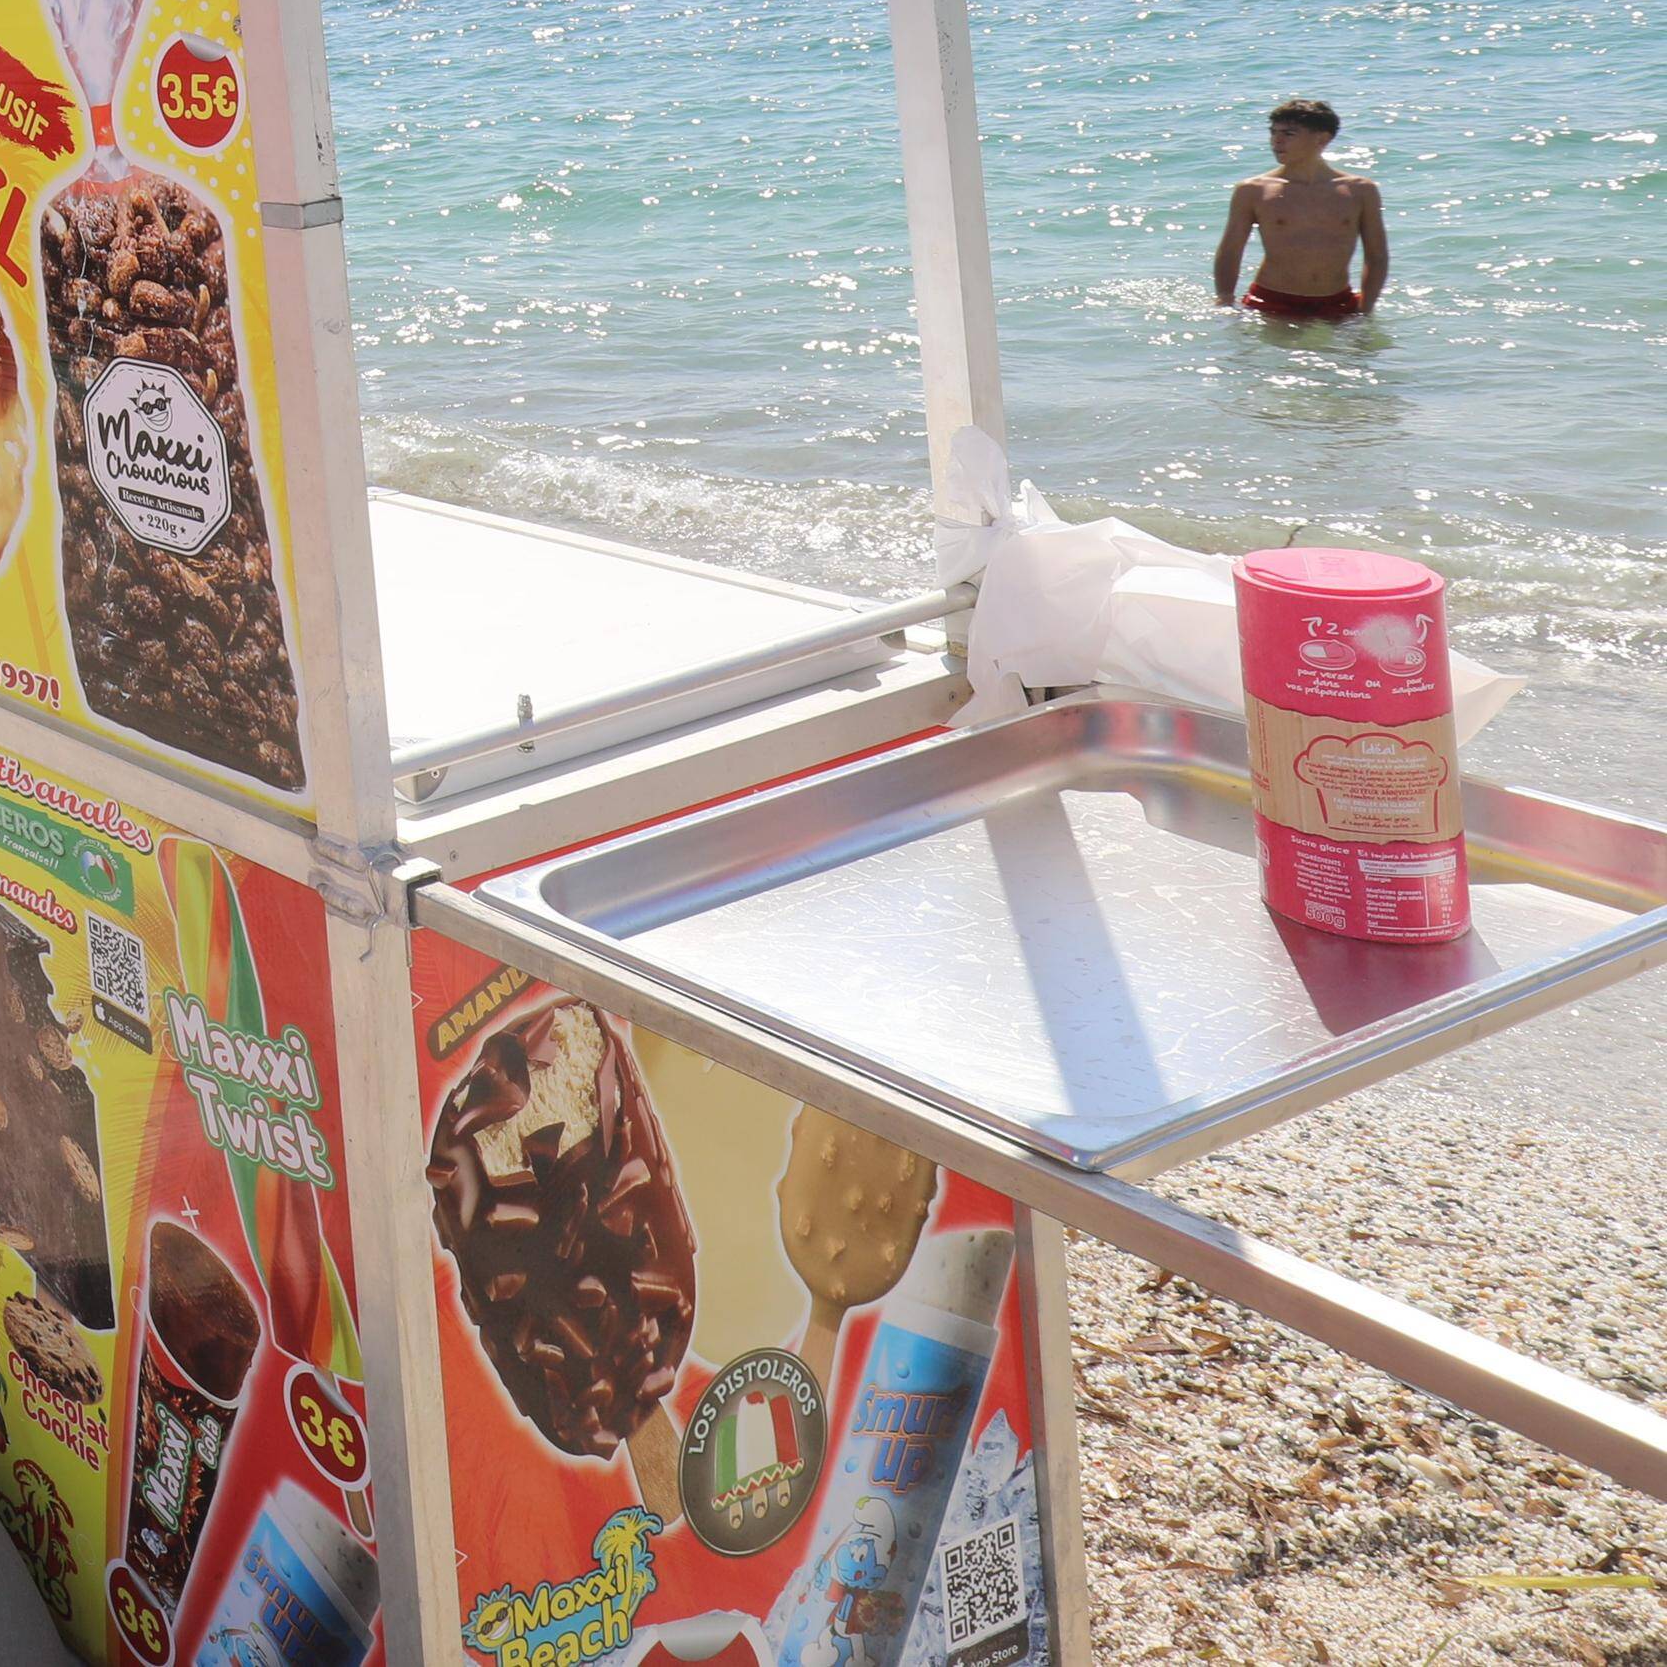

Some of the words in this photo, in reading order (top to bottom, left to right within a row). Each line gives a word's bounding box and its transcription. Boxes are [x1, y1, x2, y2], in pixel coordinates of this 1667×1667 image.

[161, 72, 237, 120] 3.5€
[97, 409, 213, 473] Maxxi
[106, 450, 211, 496] Chouchous
[122, 489, 155, 508] Recette
[156, 496, 202, 518] Artisanale
[147, 513, 178, 538] 220g
[1312, 678, 1341, 689] dans
[1361, 740, 1396, 756] Idéal
[1290, 835, 1317, 848] Sucre
[1319, 843, 1350, 855] glace
[108, 1015, 124, 1032] App
[124, 1024, 147, 1044] Store
[169, 997, 312, 1099] Maxxi
[189, 1073, 327, 1179] Twist
[8, 1350, 111, 1455] Chocolat
[21, 1389, 100, 1471] Cookie
[689, 1403, 717, 1456] LOS
[714, 1358, 817, 1417] PISTOLEROS
[198, 1416, 221, 1465] Cola
[299, 1395, 356, 1468] 3€
[145, 1406, 188, 1524] Maxxi
[118, 1587, 162, 1653] 3€
[514, 1554, 628, 1637] Maxxi
[991, 1644, 1019, 1665] Store
